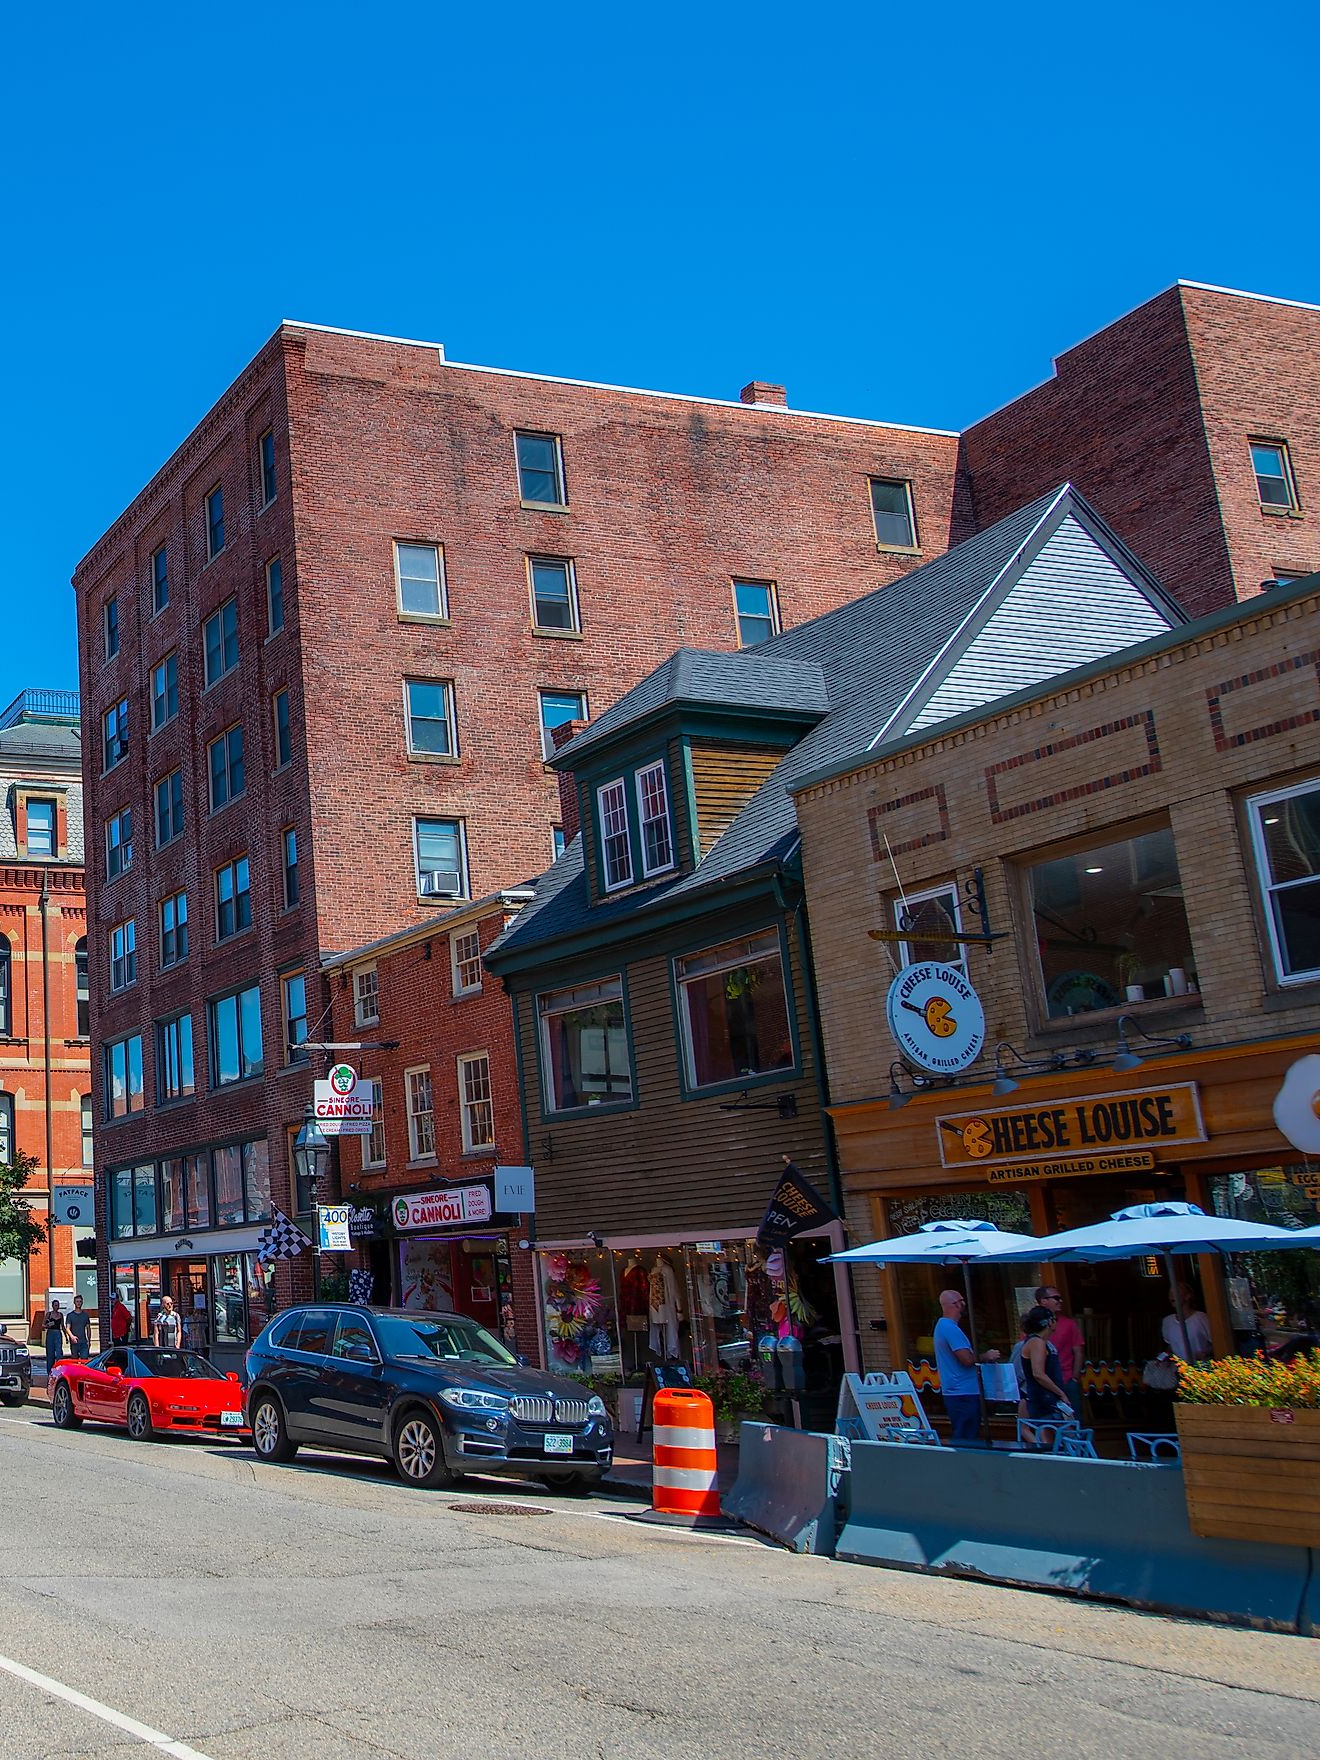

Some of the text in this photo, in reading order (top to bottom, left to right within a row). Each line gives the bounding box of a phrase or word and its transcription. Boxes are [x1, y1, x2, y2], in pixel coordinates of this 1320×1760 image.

[900, 967, 972, 1001] CHEESE LOUISE
[903, 1032, 982, 1067] ARTISAN GRILLED CHEESE
[316, 1103, 372, 1116] CANNOLI
[1076, 1095, 1177, 1145] LOUISE
[989, 1155, 1151, 1181] ARTISAN GRILLED CHEESE
[58, 1189, 89, 1198] FATFACE
[781, 1181, 819, 1216] CHEESE
[412, 1202, 462, 1224] CANNOLI
[766, 1210, 798, 1228] PEN
[545, 1438, 557, 1448] 522
